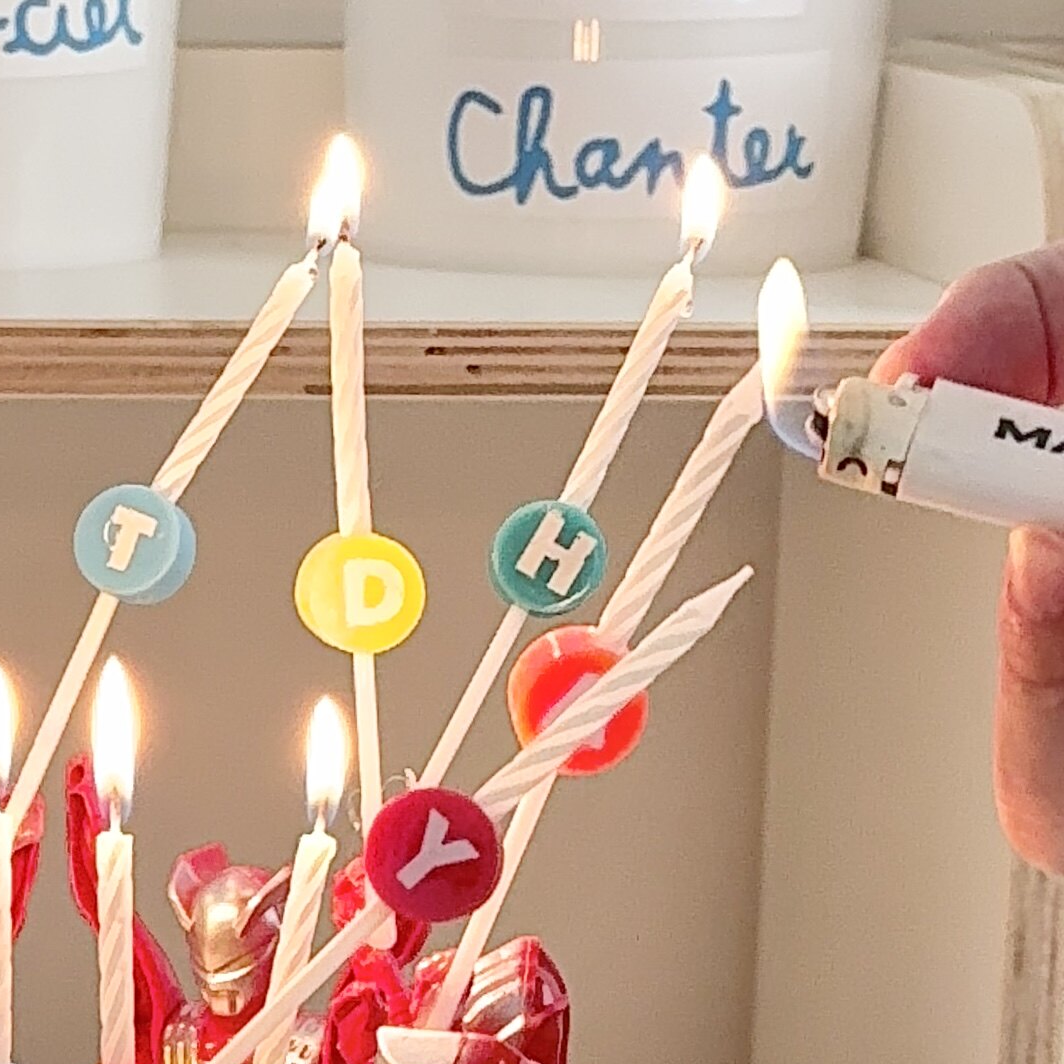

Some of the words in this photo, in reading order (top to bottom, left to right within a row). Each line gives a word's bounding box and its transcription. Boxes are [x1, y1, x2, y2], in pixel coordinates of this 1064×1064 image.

[447, 79, 814, 206] Chanter
[994, 417, 1064, 454] M
[105, 503, 159, 573] T
[514, 508, 598, 597] H
[342, 556, 406, 628] D
[395, 807, 481, 891] Y
